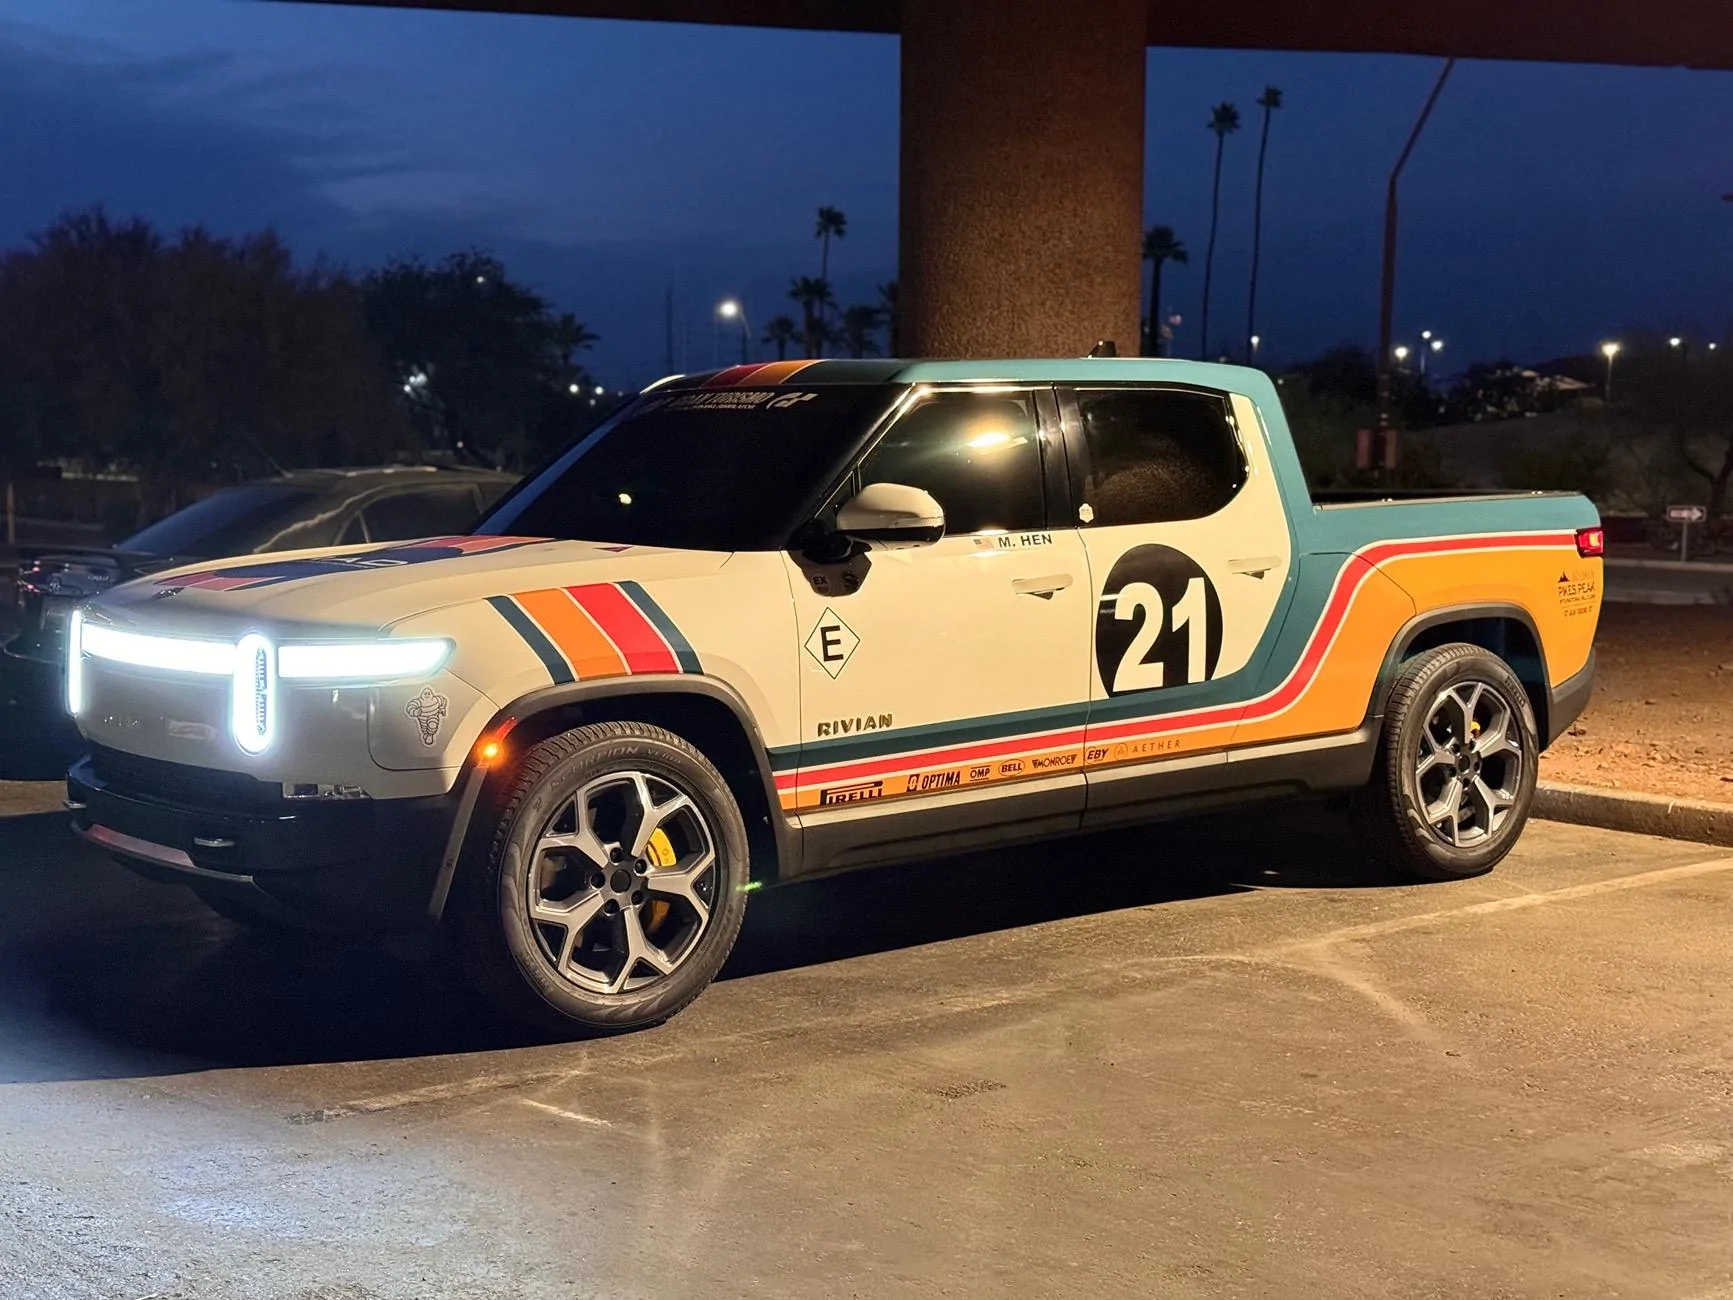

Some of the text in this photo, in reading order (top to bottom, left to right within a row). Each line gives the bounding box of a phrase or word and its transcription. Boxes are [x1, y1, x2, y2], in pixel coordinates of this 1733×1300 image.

[998, 534, 1053, 548] M. HEN
[820, 625, 844, 662] E
[1112, 577, 1206, 693] 21
[817, 713, 893, 737] RIVIAN
[819, 739, 1181, 806] PIRELLI OPTIMA OMP BELL MONROE EBY AETHER
